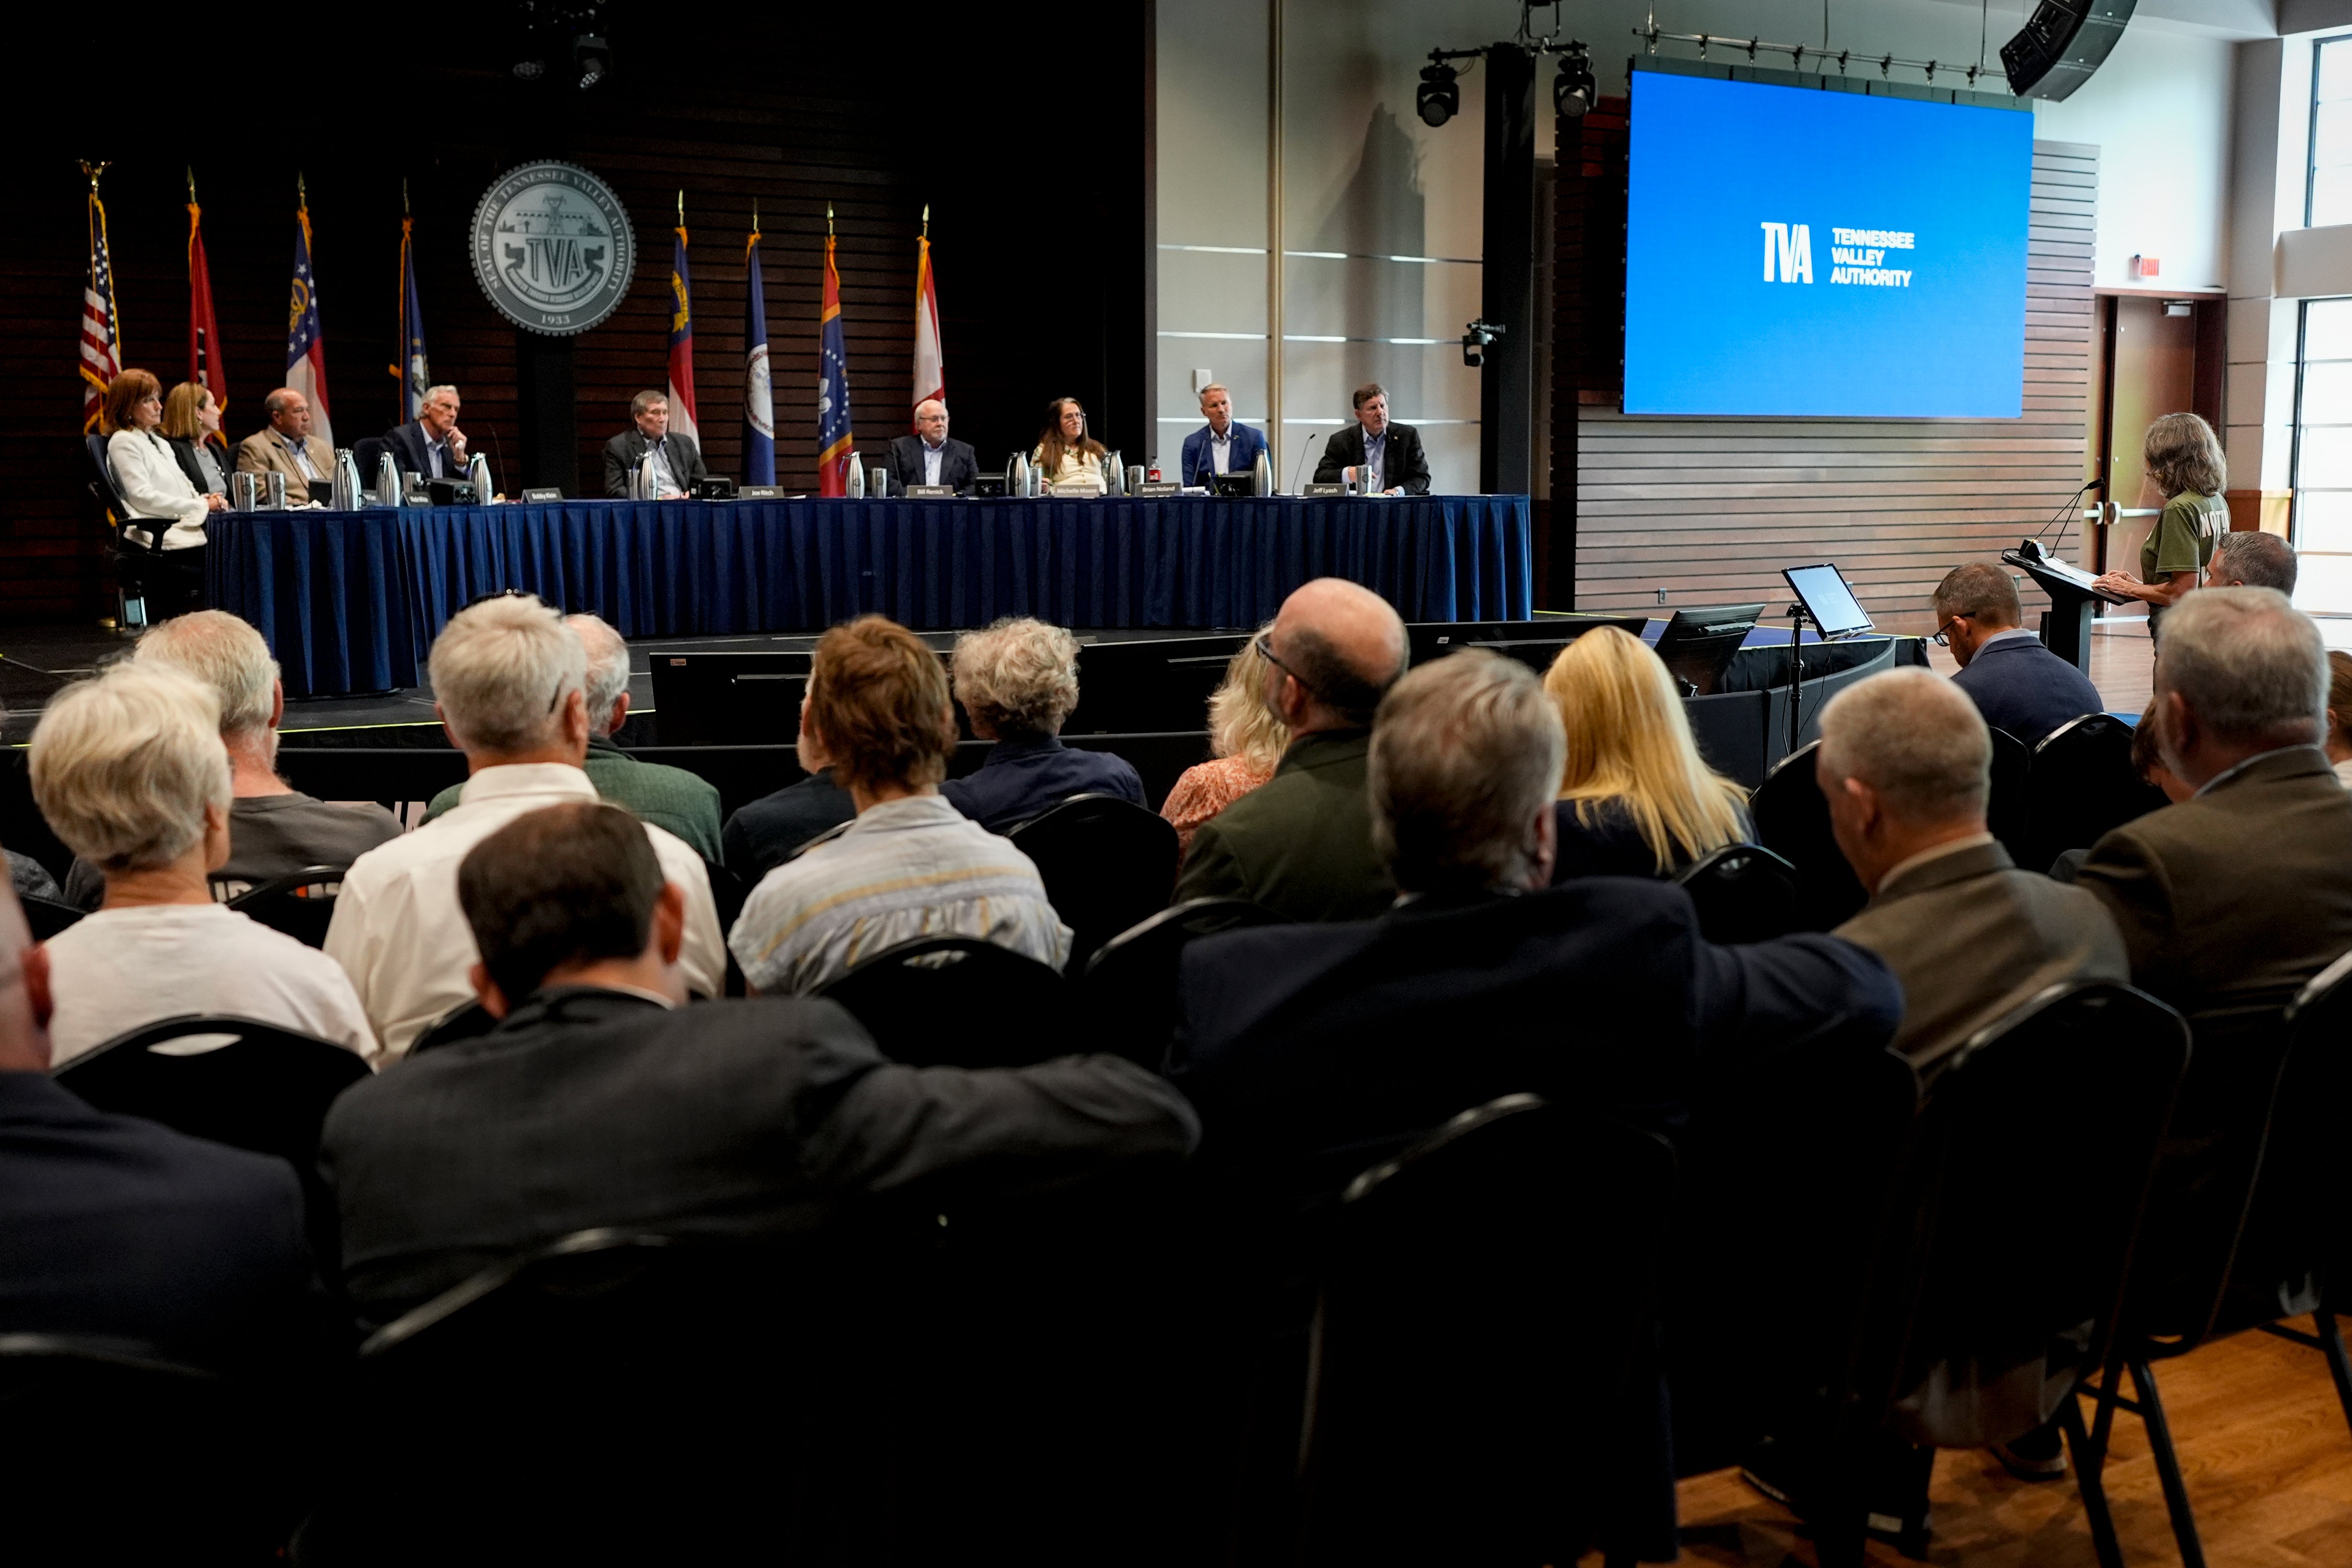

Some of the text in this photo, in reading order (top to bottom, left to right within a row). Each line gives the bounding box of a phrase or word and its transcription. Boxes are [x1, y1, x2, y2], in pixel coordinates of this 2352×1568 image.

[479, 170, 625, 290] SEAL OF THE TENNESSEE VALLEY AUTHORITY
[1832, 228, 1915, 249] TENNESSEE
[1761, 222, 1813, 284] TVA
[1831, 247, 1885, 266] VALLEY
[525, 238, 585, 289] TVA
[2141, 259, 2158, 275] EXIT
[1831, 267, 1912, 287] AUTHORITY
[541, 314, 570, 325] 1933
